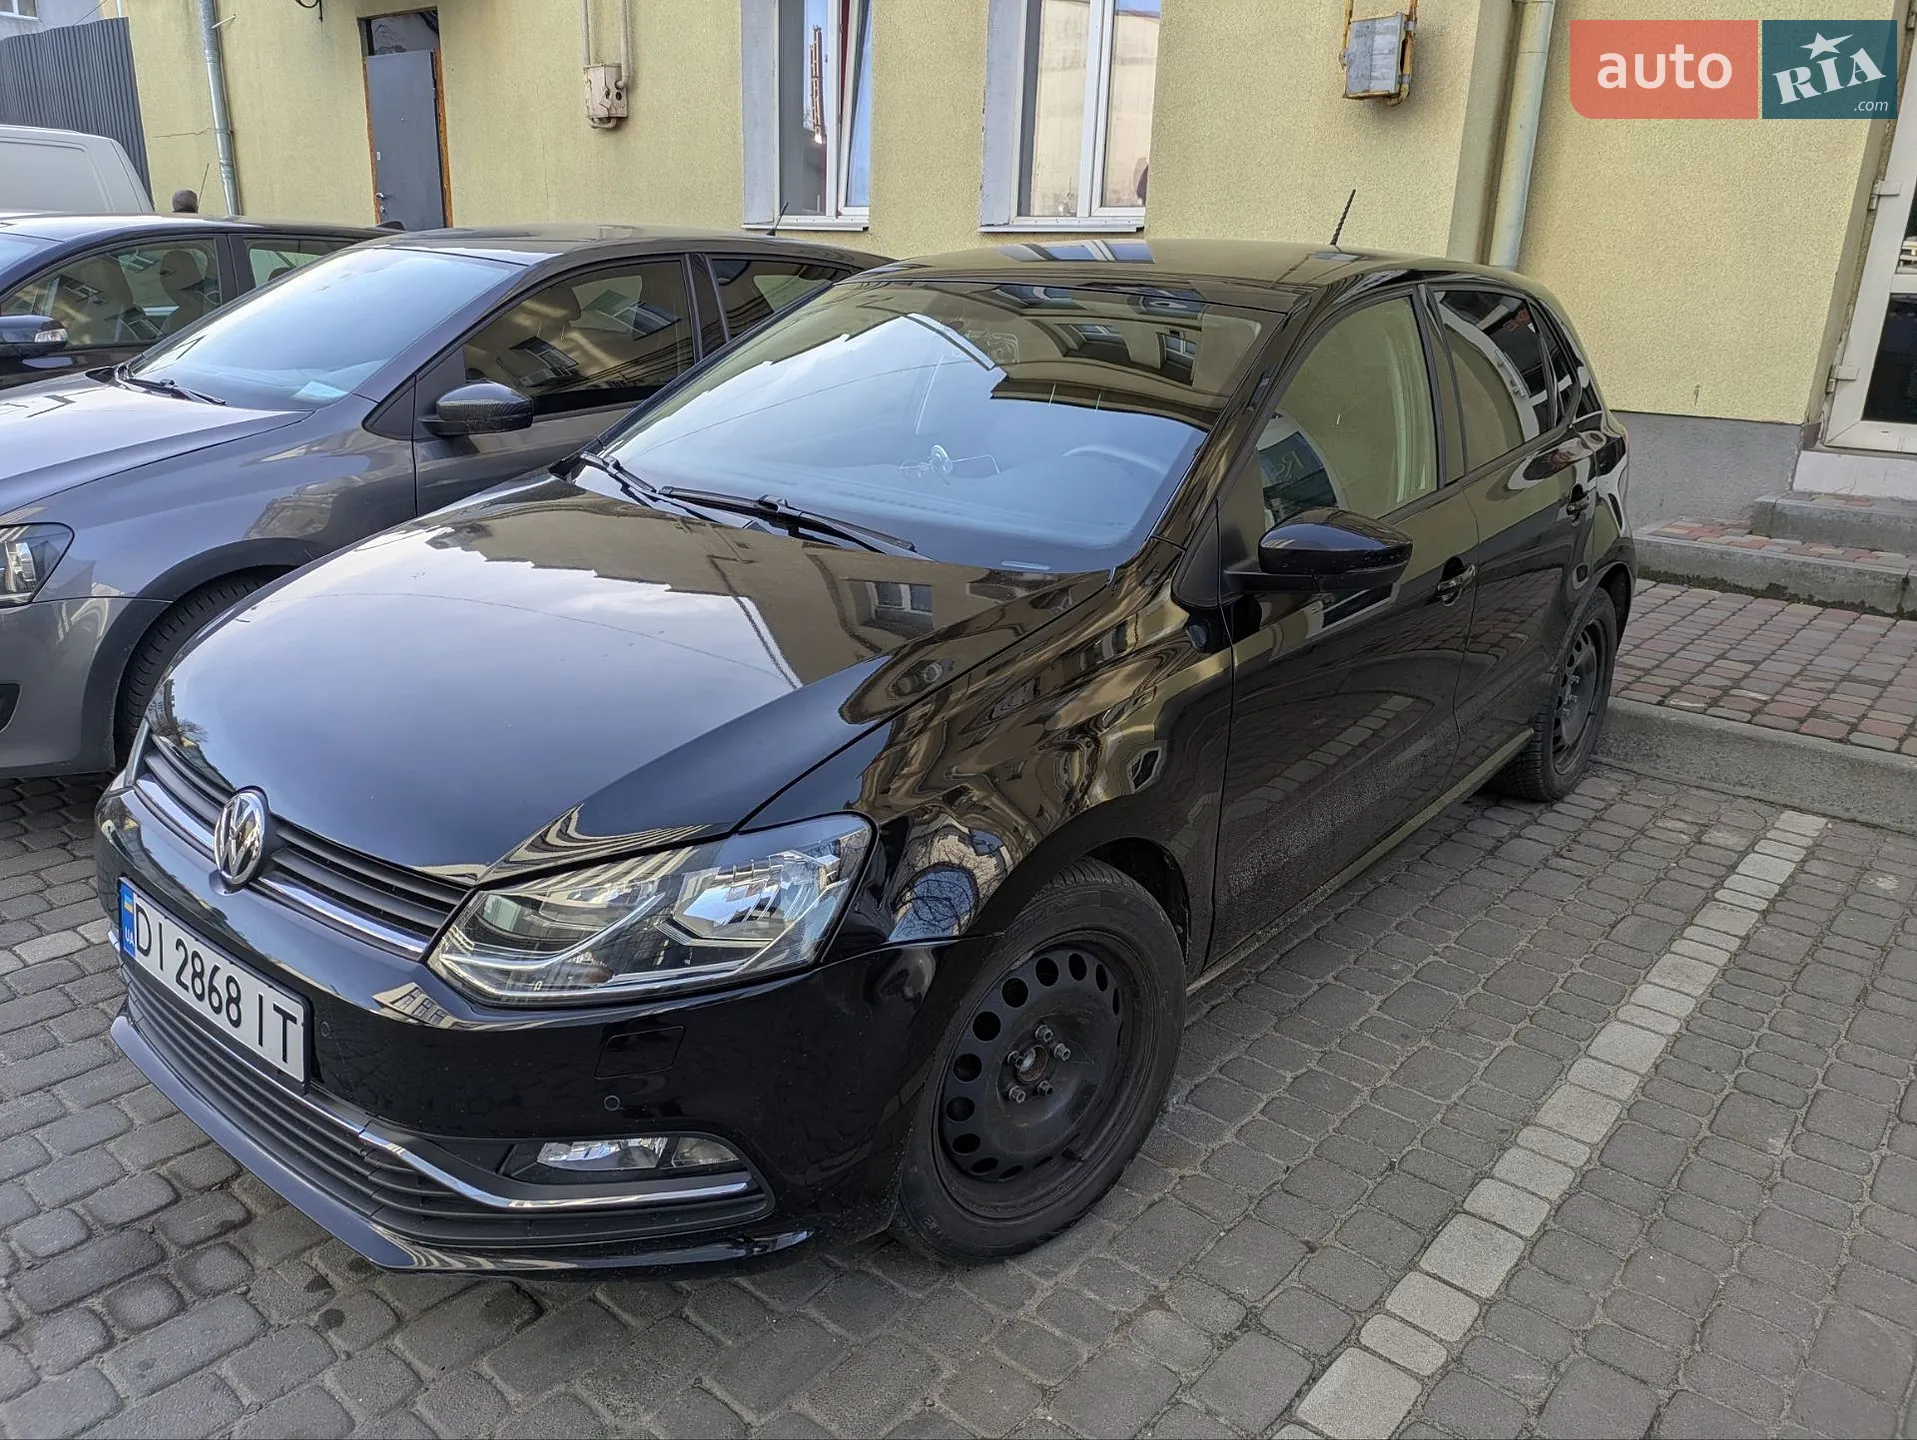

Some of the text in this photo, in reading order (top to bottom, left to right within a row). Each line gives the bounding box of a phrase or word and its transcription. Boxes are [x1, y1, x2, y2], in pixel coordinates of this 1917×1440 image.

[124, 926, 135, 946] UA
[135, 902, 298, 1064] DI 2868 IT
